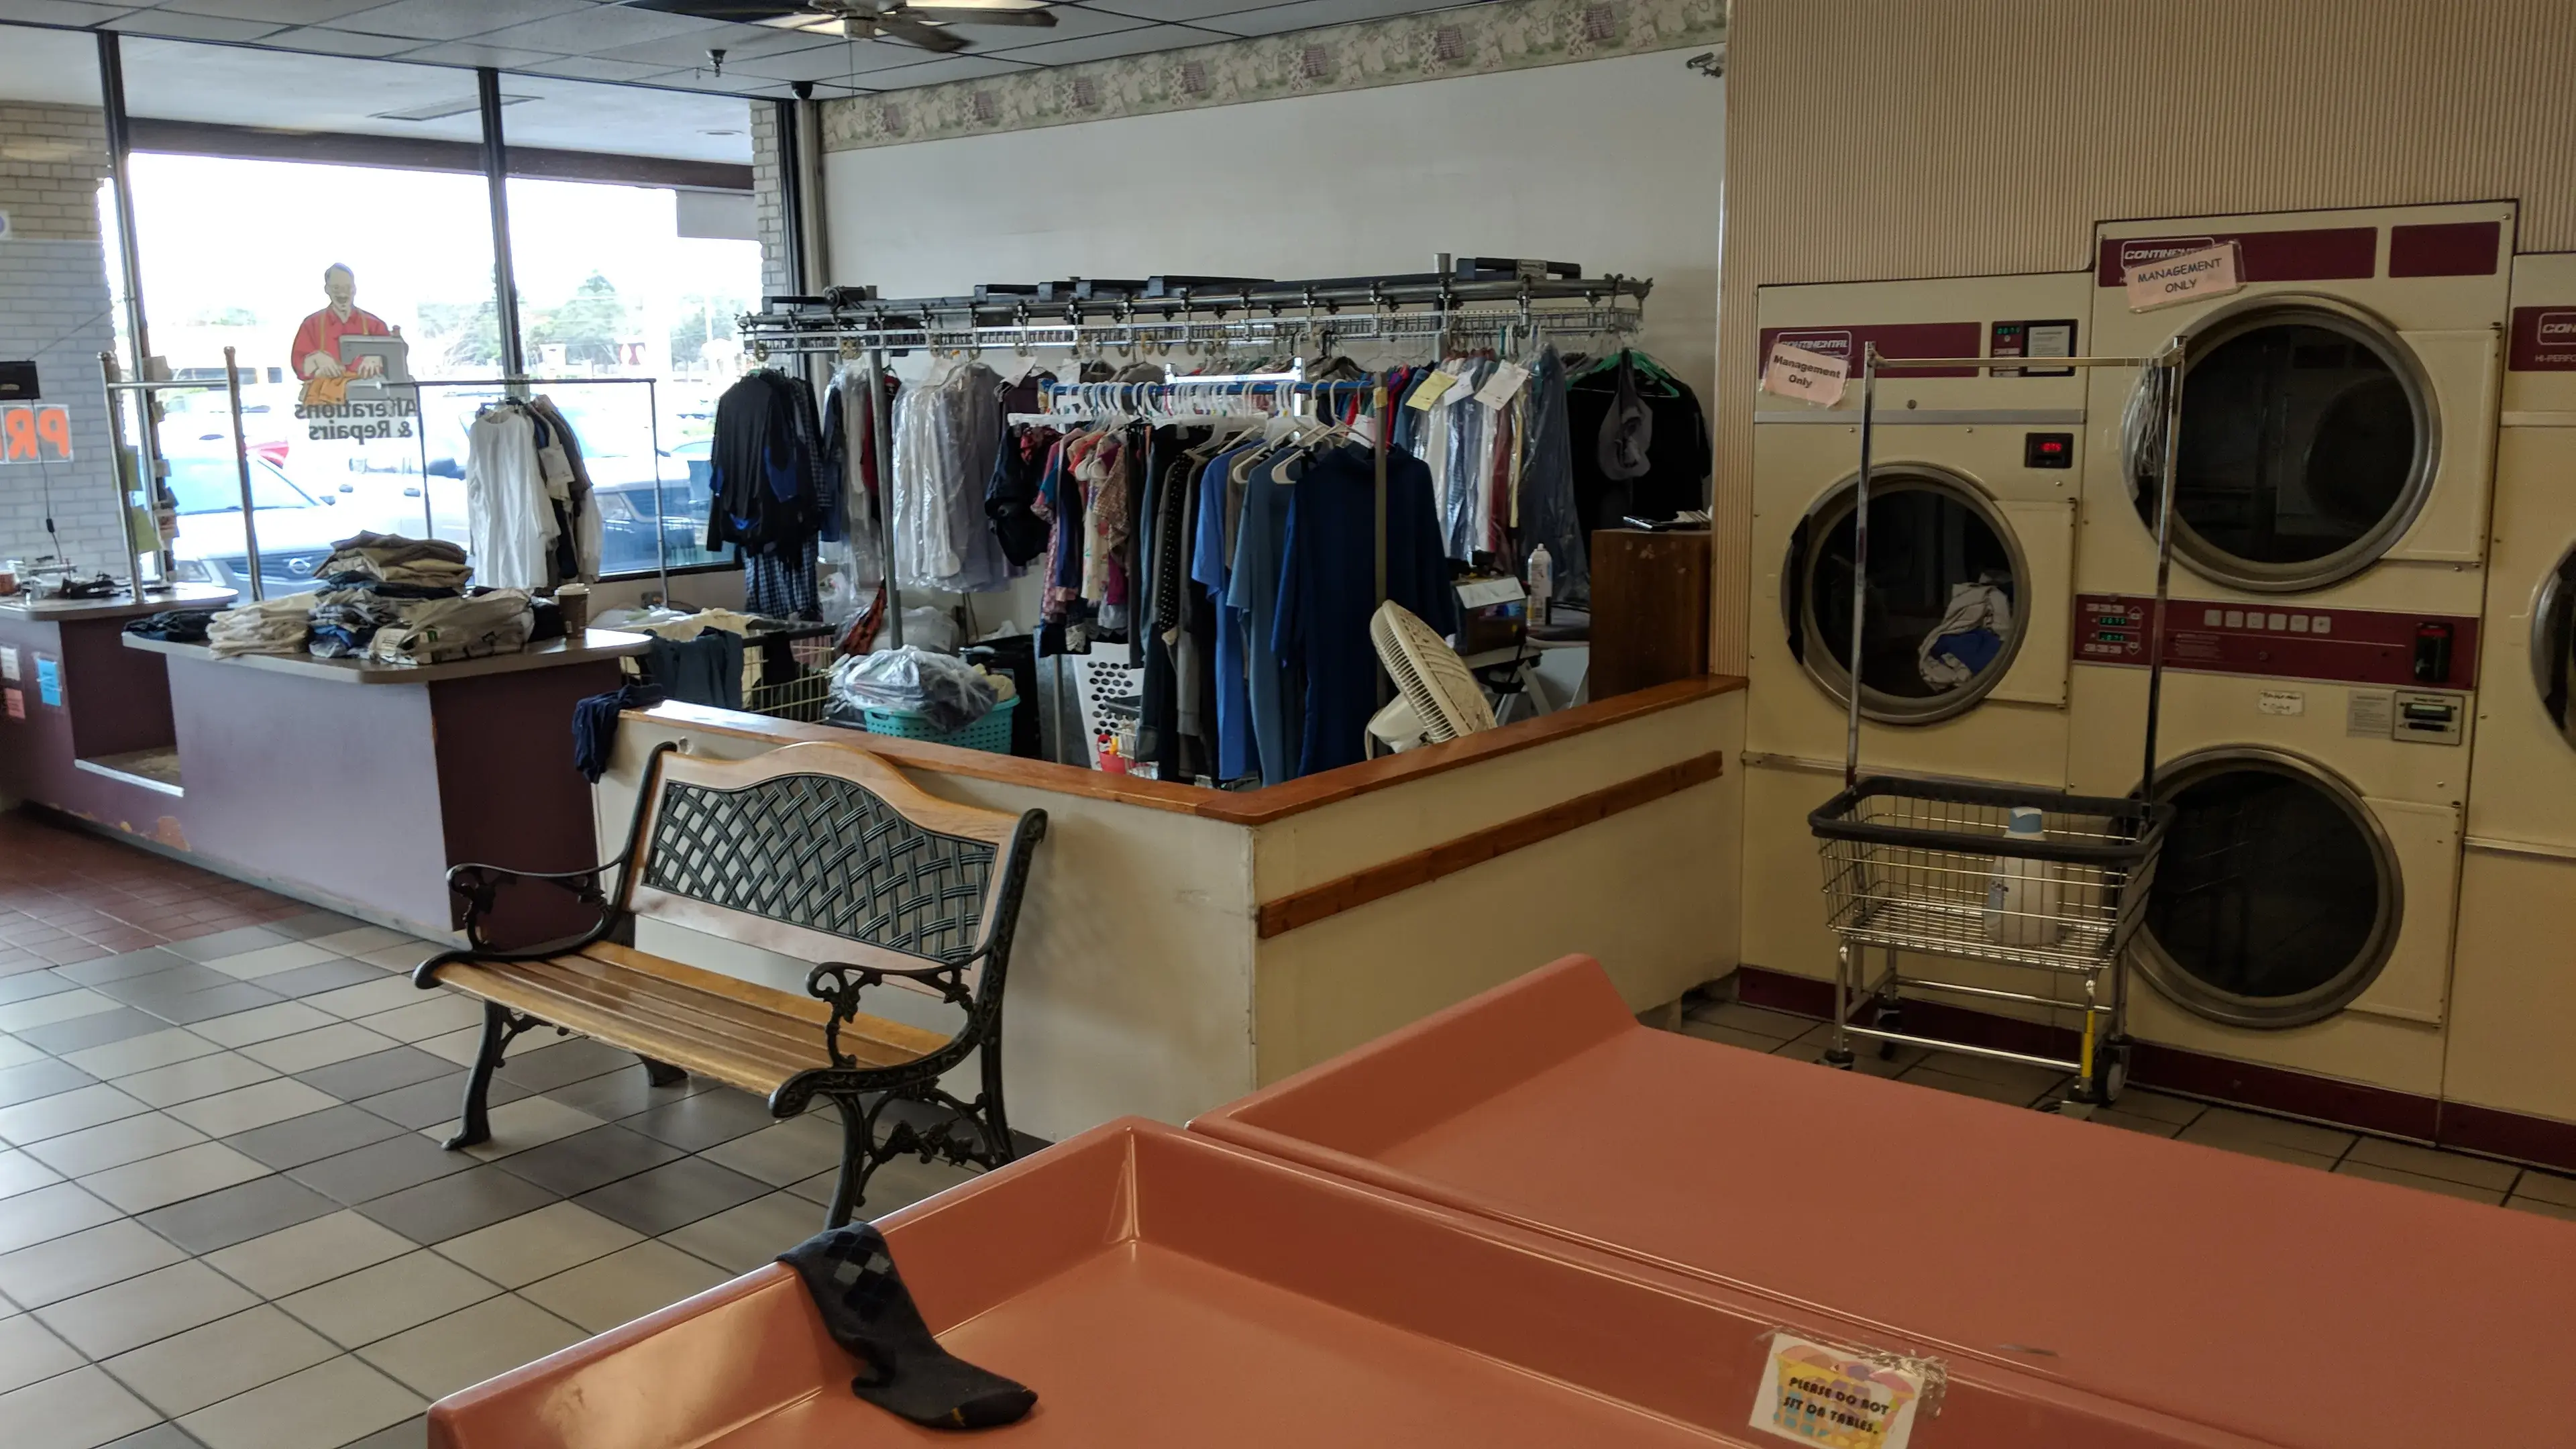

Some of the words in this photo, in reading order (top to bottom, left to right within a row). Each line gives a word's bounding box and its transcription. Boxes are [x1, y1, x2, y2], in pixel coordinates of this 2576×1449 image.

[2138, 258, 2222, 282] MANAGEMENT
[2165, 279, 2197, 293] ONLY
[1773, 355, 1841, 378] Management
[1788, 374, 1813, 388] Only
[1788, 1377, 1832, 1398] PLEASE
[1835, 1391, 1857, 1405] DO
[1861, 1398, 1889, 1415] NOT
[1783, 1396, 1803, 1410] SIT
[1830, 1410, 1879, 1435] TABLES.
